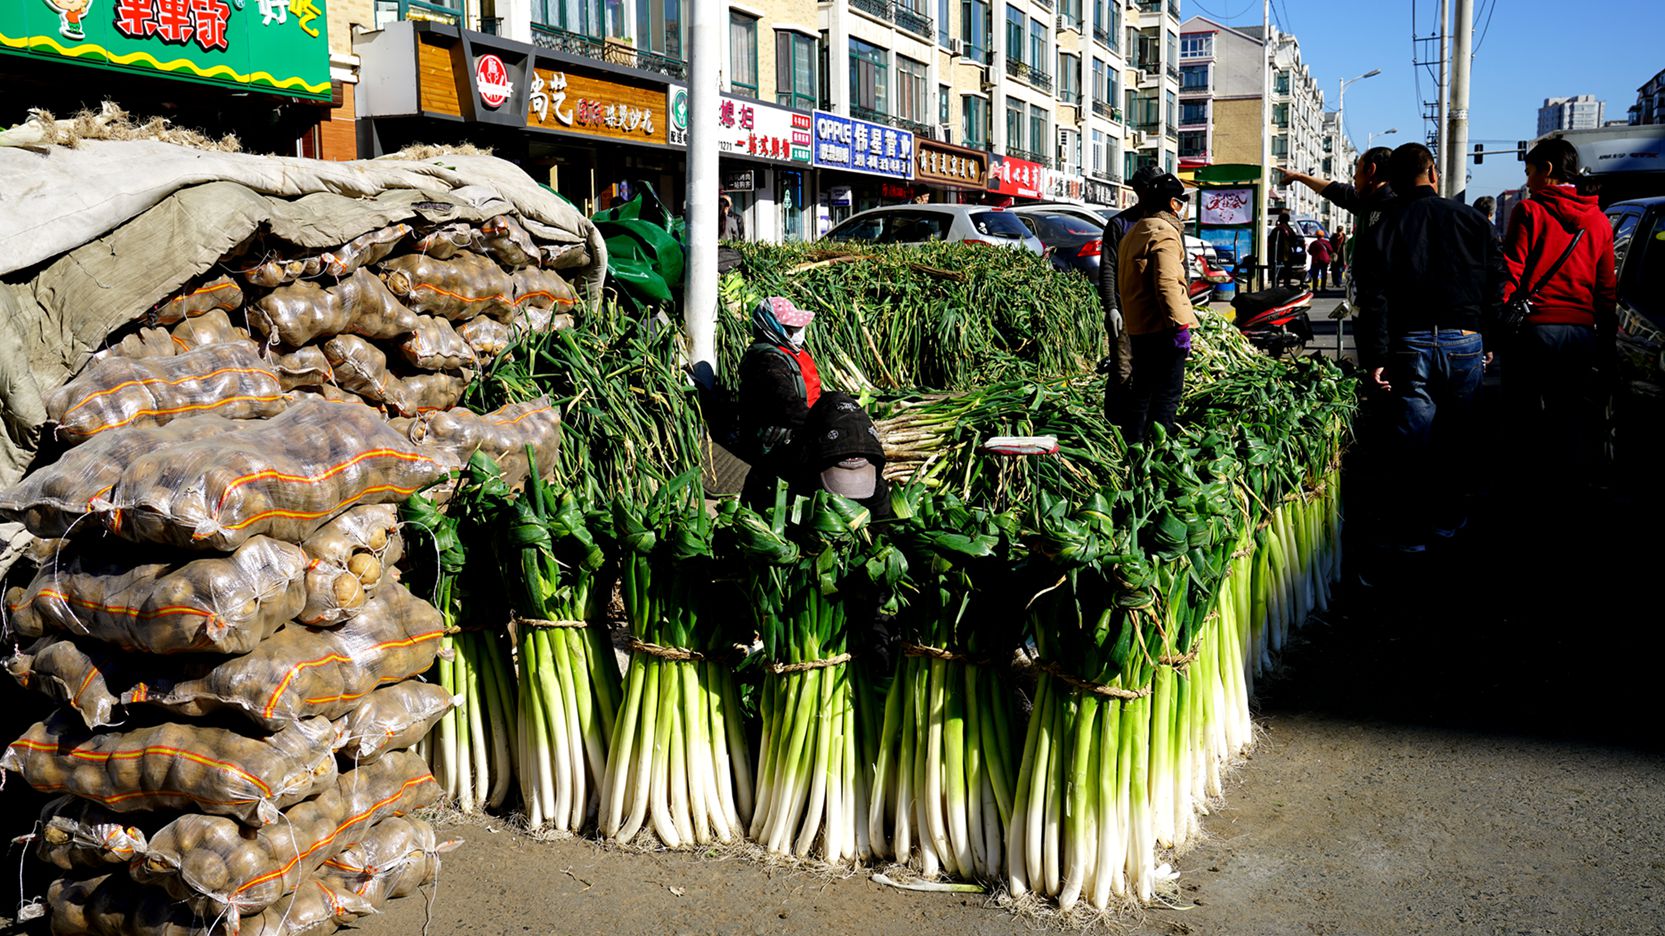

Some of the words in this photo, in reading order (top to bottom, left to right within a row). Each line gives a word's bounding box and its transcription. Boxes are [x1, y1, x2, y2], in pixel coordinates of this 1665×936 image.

[817, 118, 851, 143] OPPLE
[718, 141, 732, 151] 1271
[737, 134, 790, 160] 一站式购物
